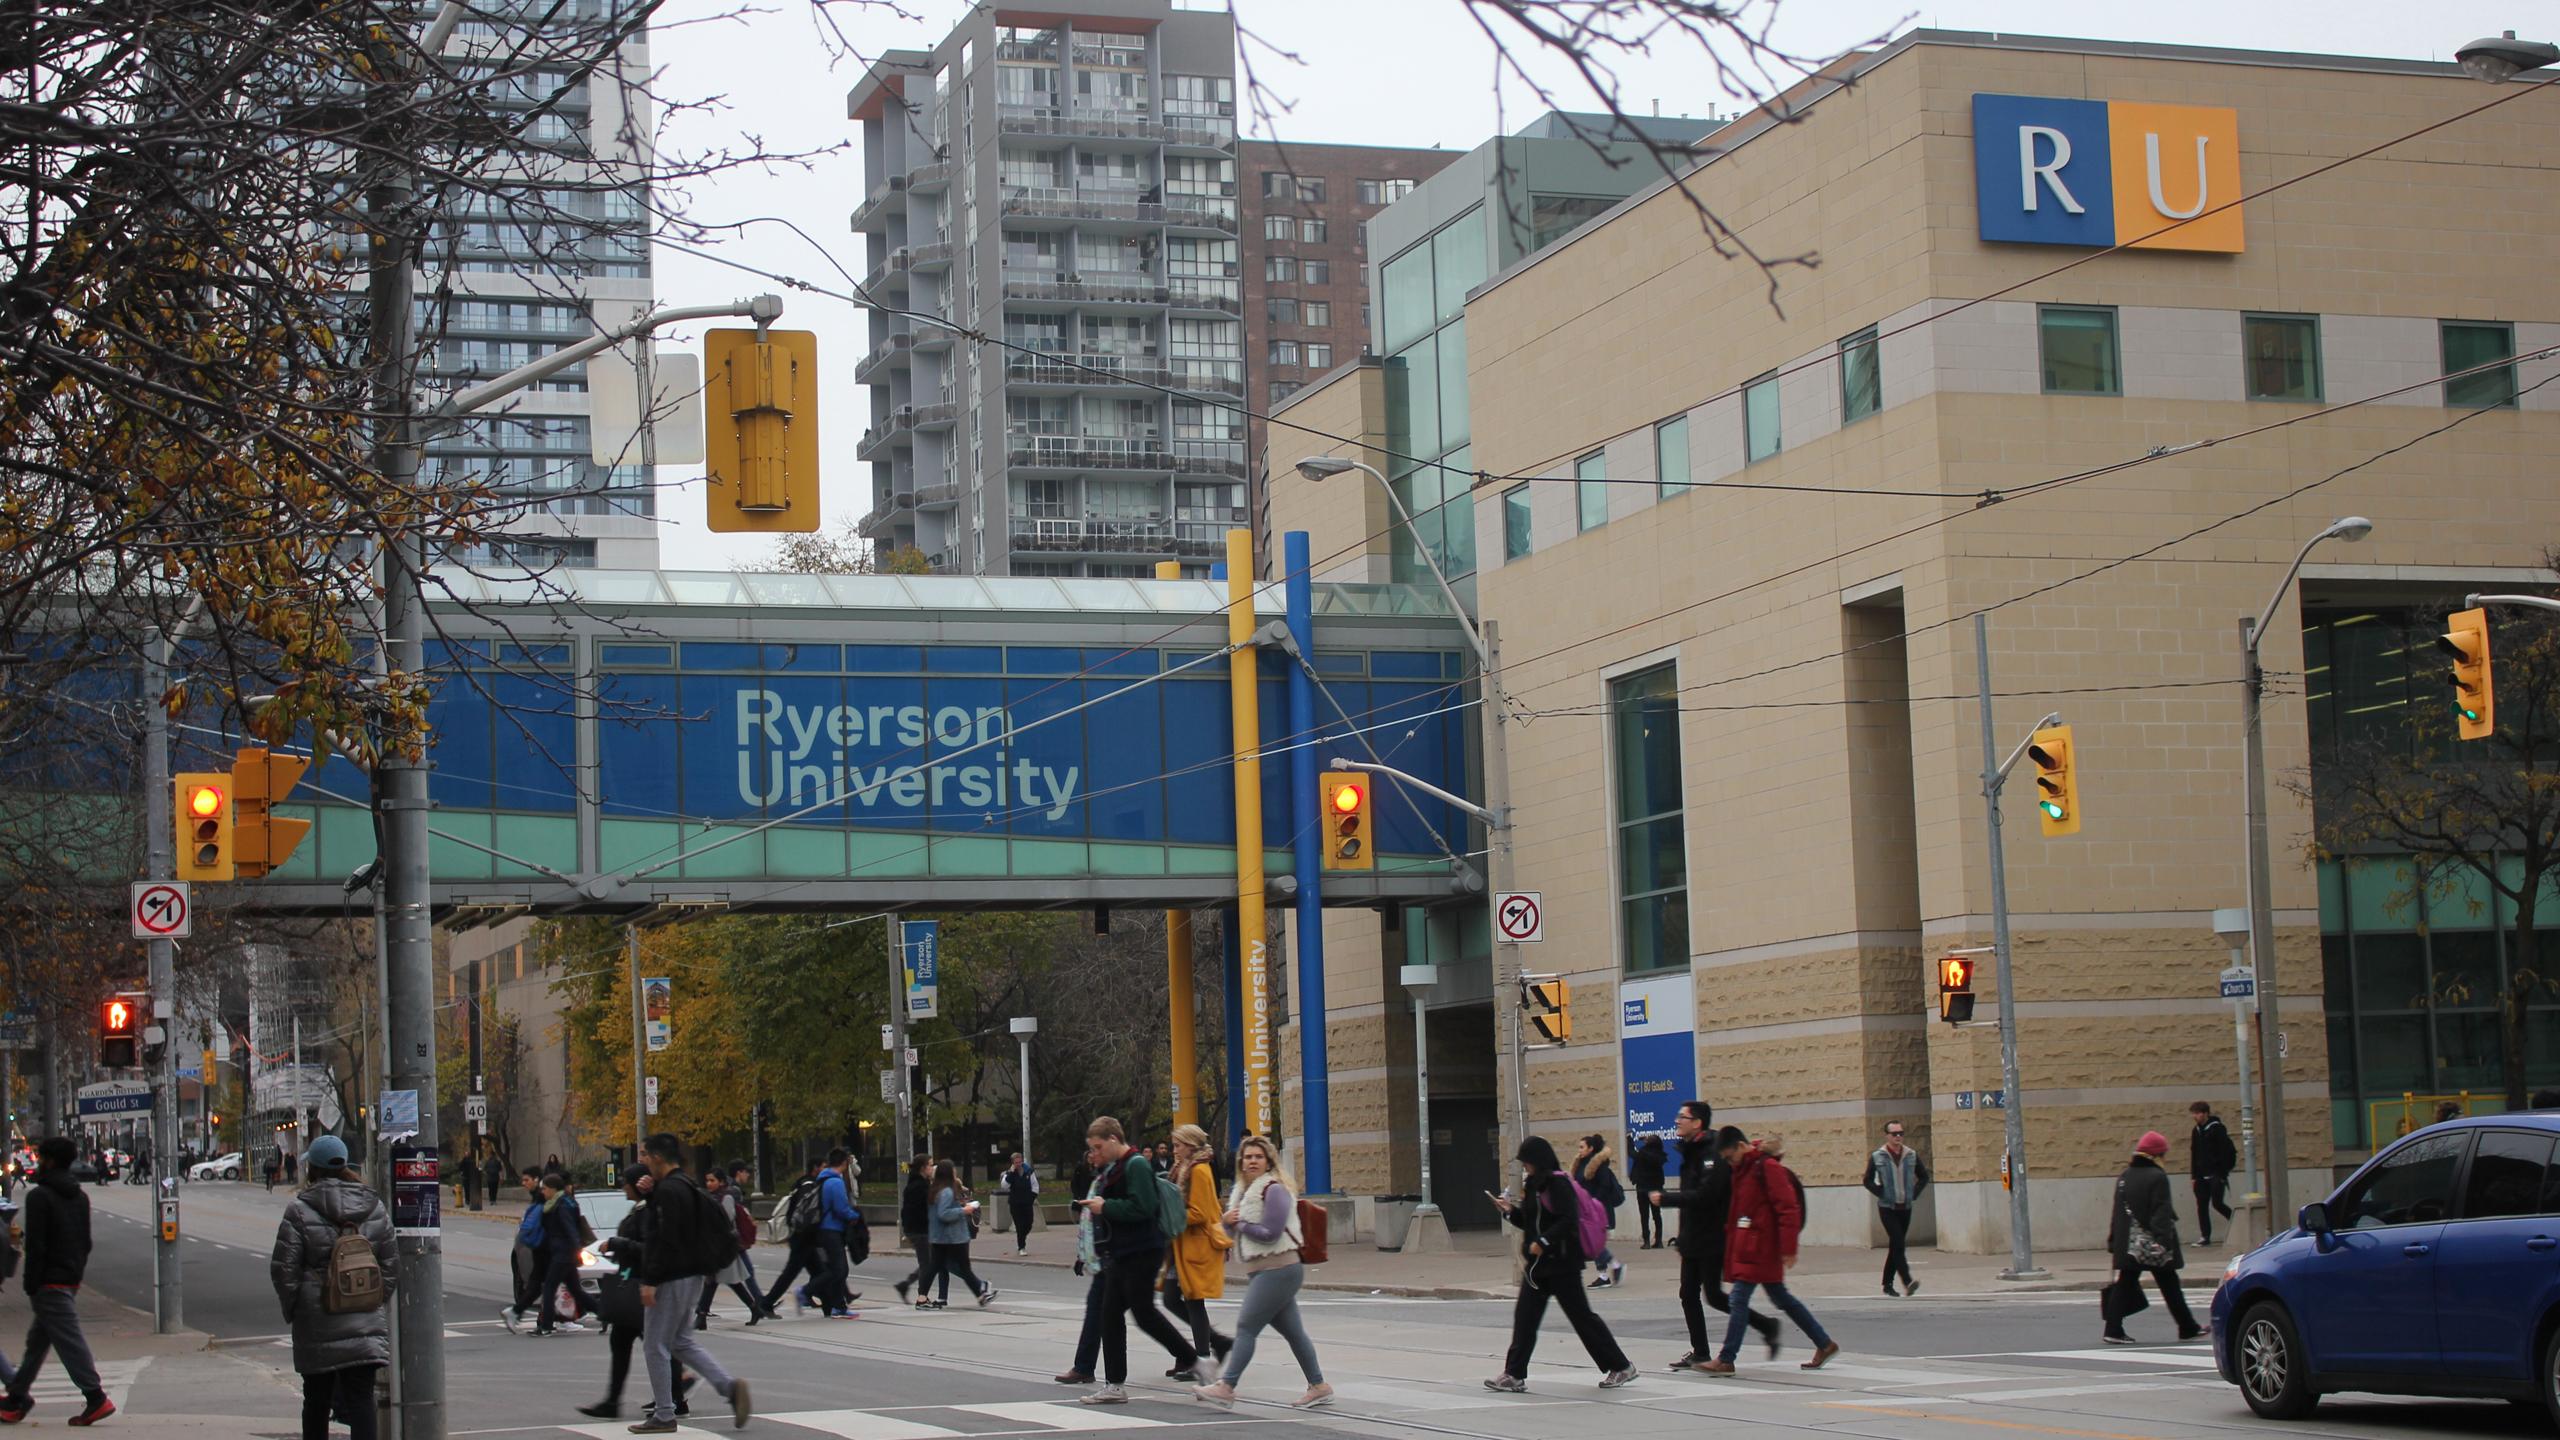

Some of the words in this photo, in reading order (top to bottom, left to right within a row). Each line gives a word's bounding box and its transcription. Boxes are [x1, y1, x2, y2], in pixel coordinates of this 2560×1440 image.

[2019, 125, 2085, 213] R
[2145, 133, 2208, 220] U
[737, 689, 1014, 760] Ryerson
[738, 750, 1078, 820] University
[917, 942, 926, 979] Ryerson
[925, 932, 934, 978] University
[1248, 939, 1270, 1069] University
[1626, 1005, 1641, 1015] Ryerson
[1626, 1013, 1645, 1022] University
[85, 1088, 113, 1097] GARDEN
[116, 1087, 146, 1095] DISTRICT
[1628, 1083, 1640, 1093] RCC
[1652, 1081, 1666, 1091] Gould
[95, 1097, 127, 1111] Gould
[130, 1099, 139, 1108] St
[468, 1106, 485, 1117] 40
[1258, 1074, 1272, 1133] rson
[1630, 1109, 1654, 1126] Rogers
